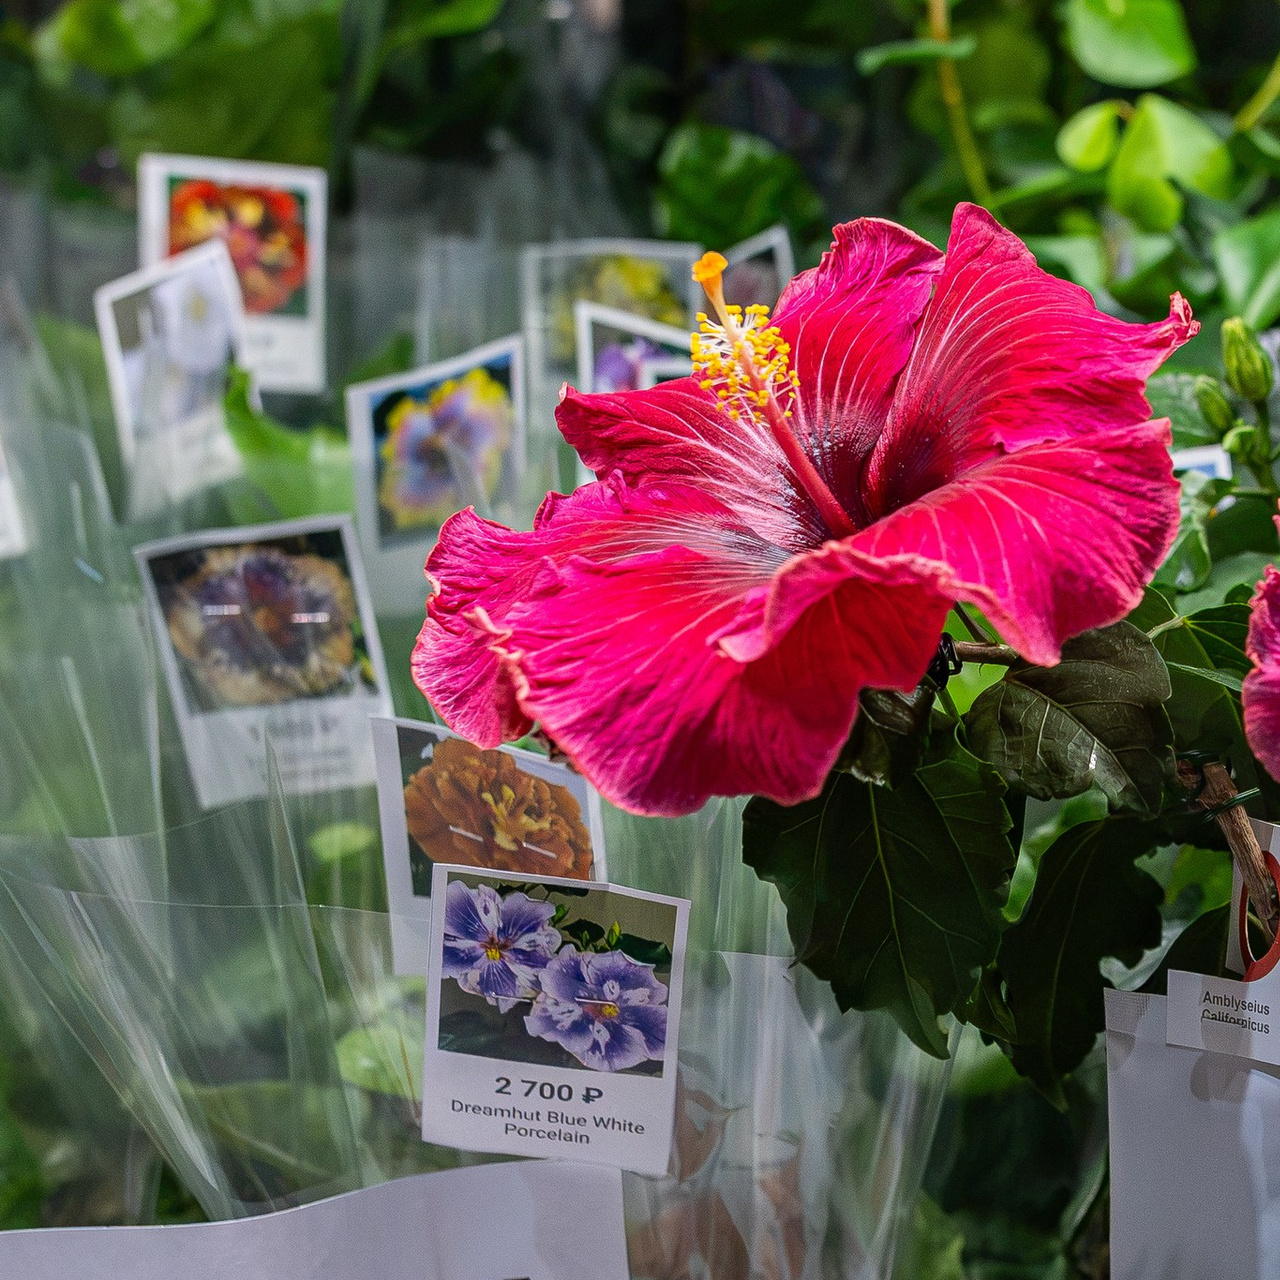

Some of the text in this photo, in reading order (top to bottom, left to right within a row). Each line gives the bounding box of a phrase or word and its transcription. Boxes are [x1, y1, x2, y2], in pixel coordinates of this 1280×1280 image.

[1202, 990, 1271, 1016] Amblyseius
[494, 1076, 512, 1096] 2
[520, 1079, 574, 1102] 700
[450, 1099, 646, 1135] Dreamhut Blue White
[504, 1123, 591, 1145] Porcelain
